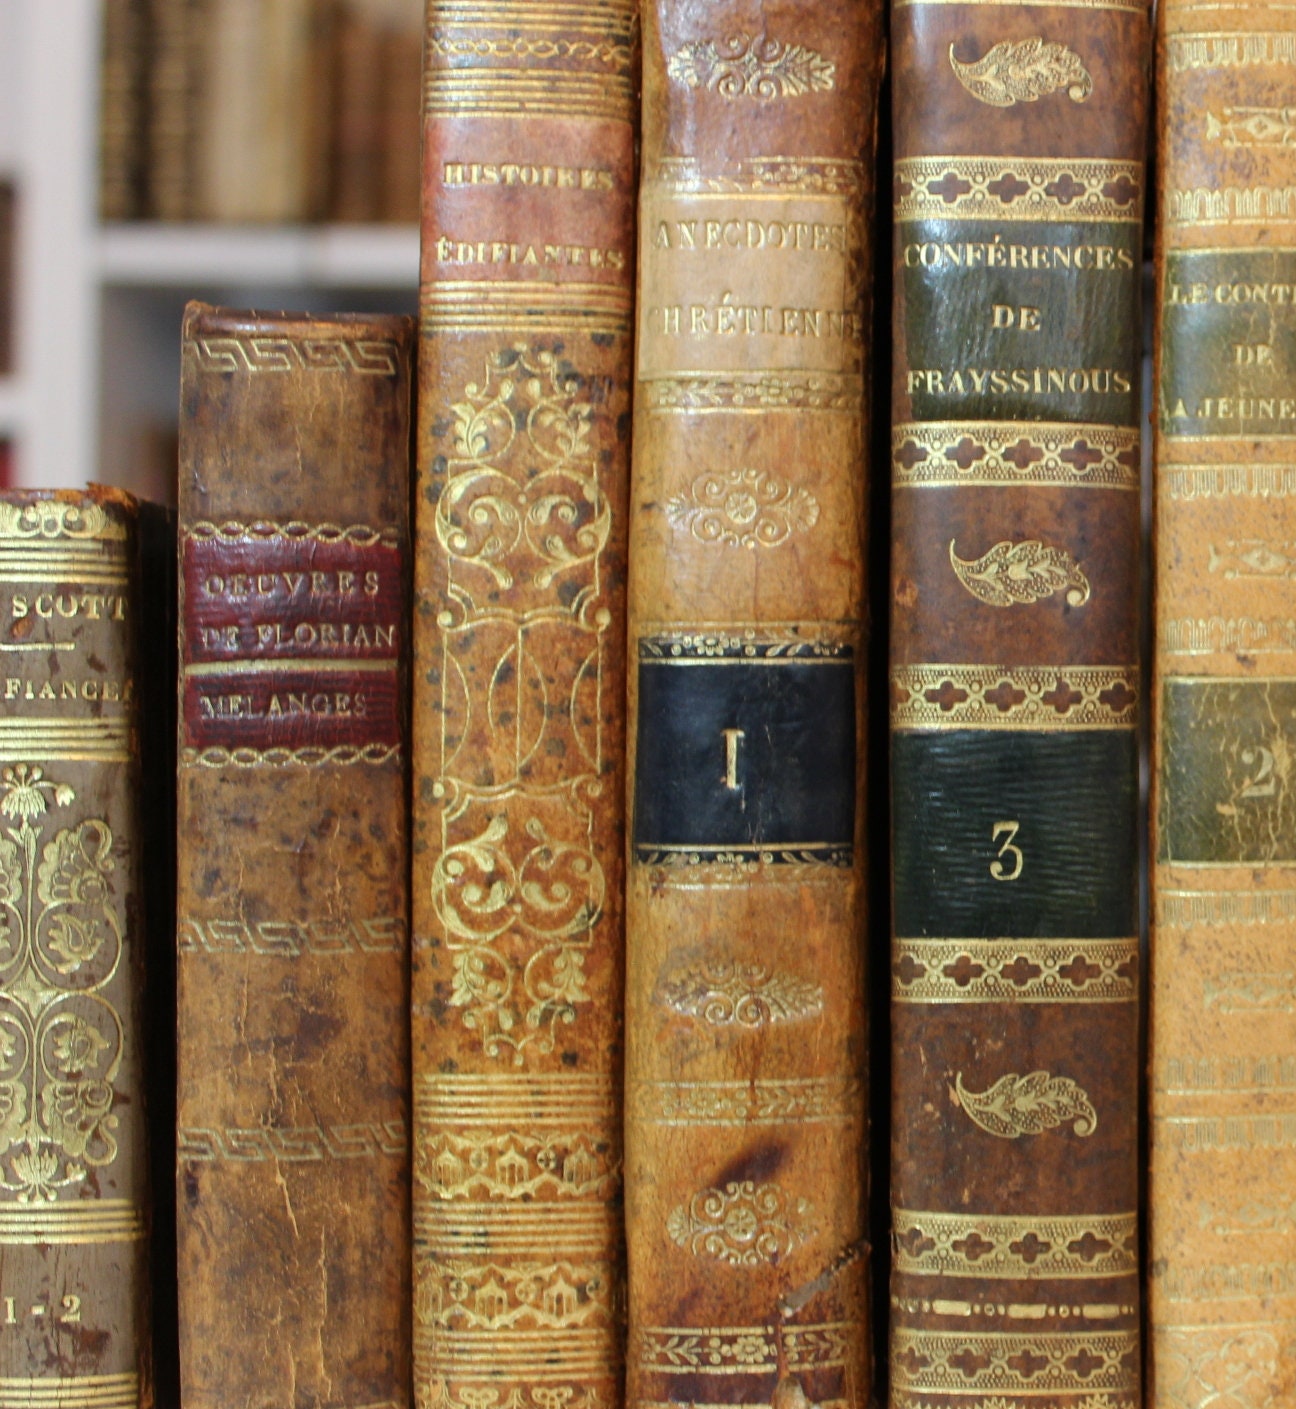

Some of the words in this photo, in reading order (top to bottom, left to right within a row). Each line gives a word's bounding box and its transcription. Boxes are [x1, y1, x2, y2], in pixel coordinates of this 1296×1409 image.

[444, 163, 613, 190] HISTOIRES
[436, 236, 625, 270] ÉDIFIANTES
[903, 234, 1134, 270] CONFÉRENCES
[1170, 282, 1208, 304] LE
[991, 303, 1042, 332] DE
[1231, 343, 1274, 366] DE
[906, 367, 1132, 395] FRAYSSINOUS
[205, 570, 380, 598] OEUVRES
[12, 593, 128, 621] SCOTT
[202, 624, 239, 651] DE
[257, 621, 396, 650] FLORIAN
[200, 692, 367, 720] MELANGES
[1240, 745, 1276, 798] 2
[989, 820, 1024, 881] 3
